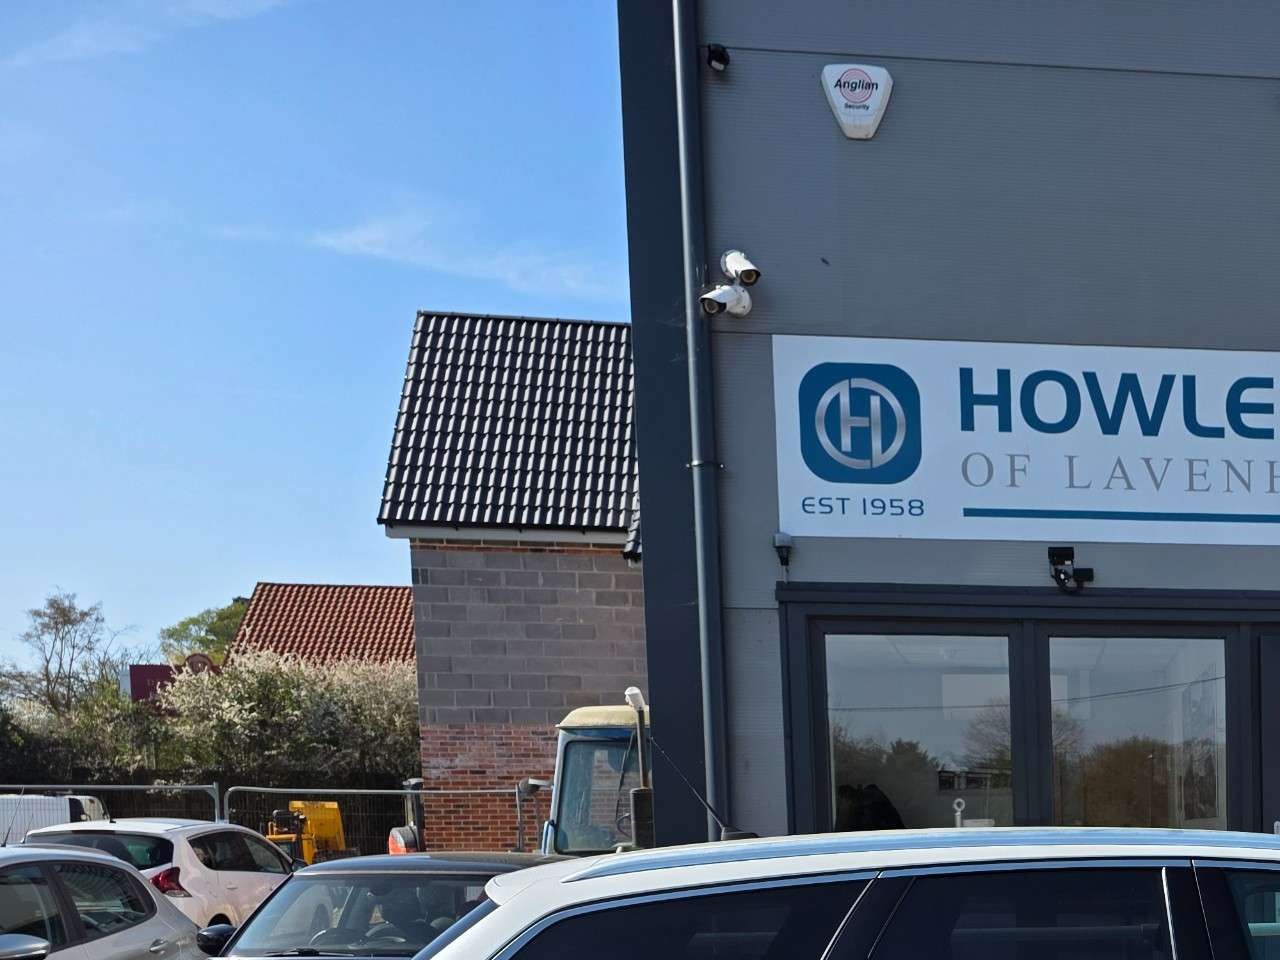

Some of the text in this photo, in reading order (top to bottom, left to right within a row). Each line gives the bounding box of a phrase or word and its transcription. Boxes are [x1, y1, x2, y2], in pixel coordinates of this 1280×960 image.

[834, 79, 878, 92] Anglian
[844, 103, 870, 111] Security
[961, 452, 1031, 488] OF
[801, 496, 925, 517] EST 1958
